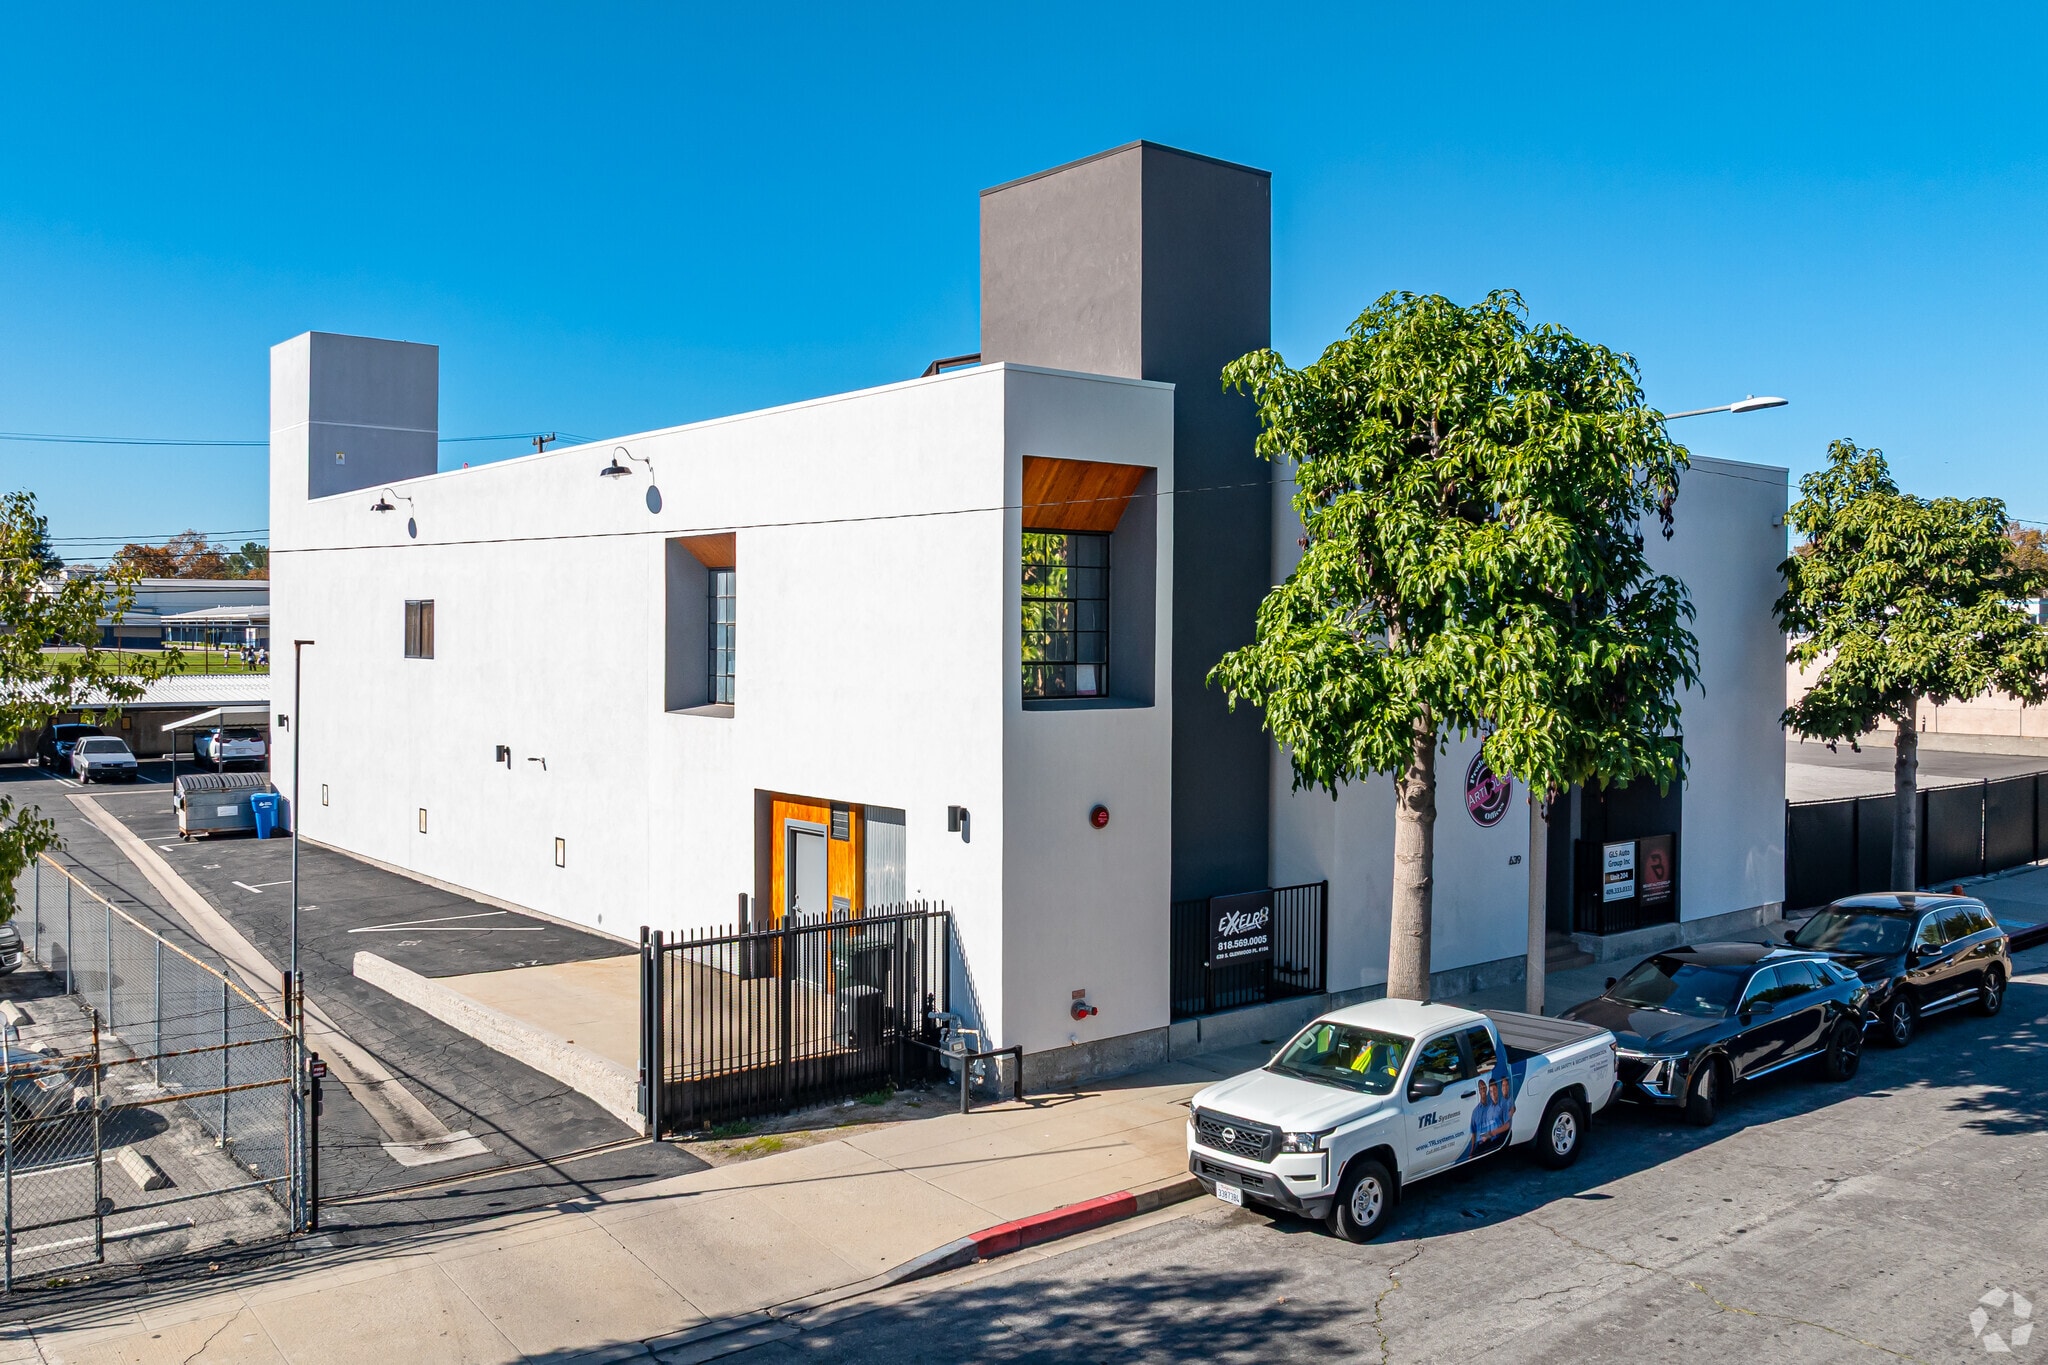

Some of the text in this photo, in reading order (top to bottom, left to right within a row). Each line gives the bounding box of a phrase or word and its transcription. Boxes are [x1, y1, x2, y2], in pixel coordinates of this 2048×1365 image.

[1509, 854, 1522, 865] 639
[1608, 850, 1618, 858] GLS
[1608, 860, 1623, 868] Group
[1218, 935, 1267, 951] 818.569.0005
[1418, 1111, 1438, 1129] TRL
[1438, 1111, 1461, 1122] Systems
